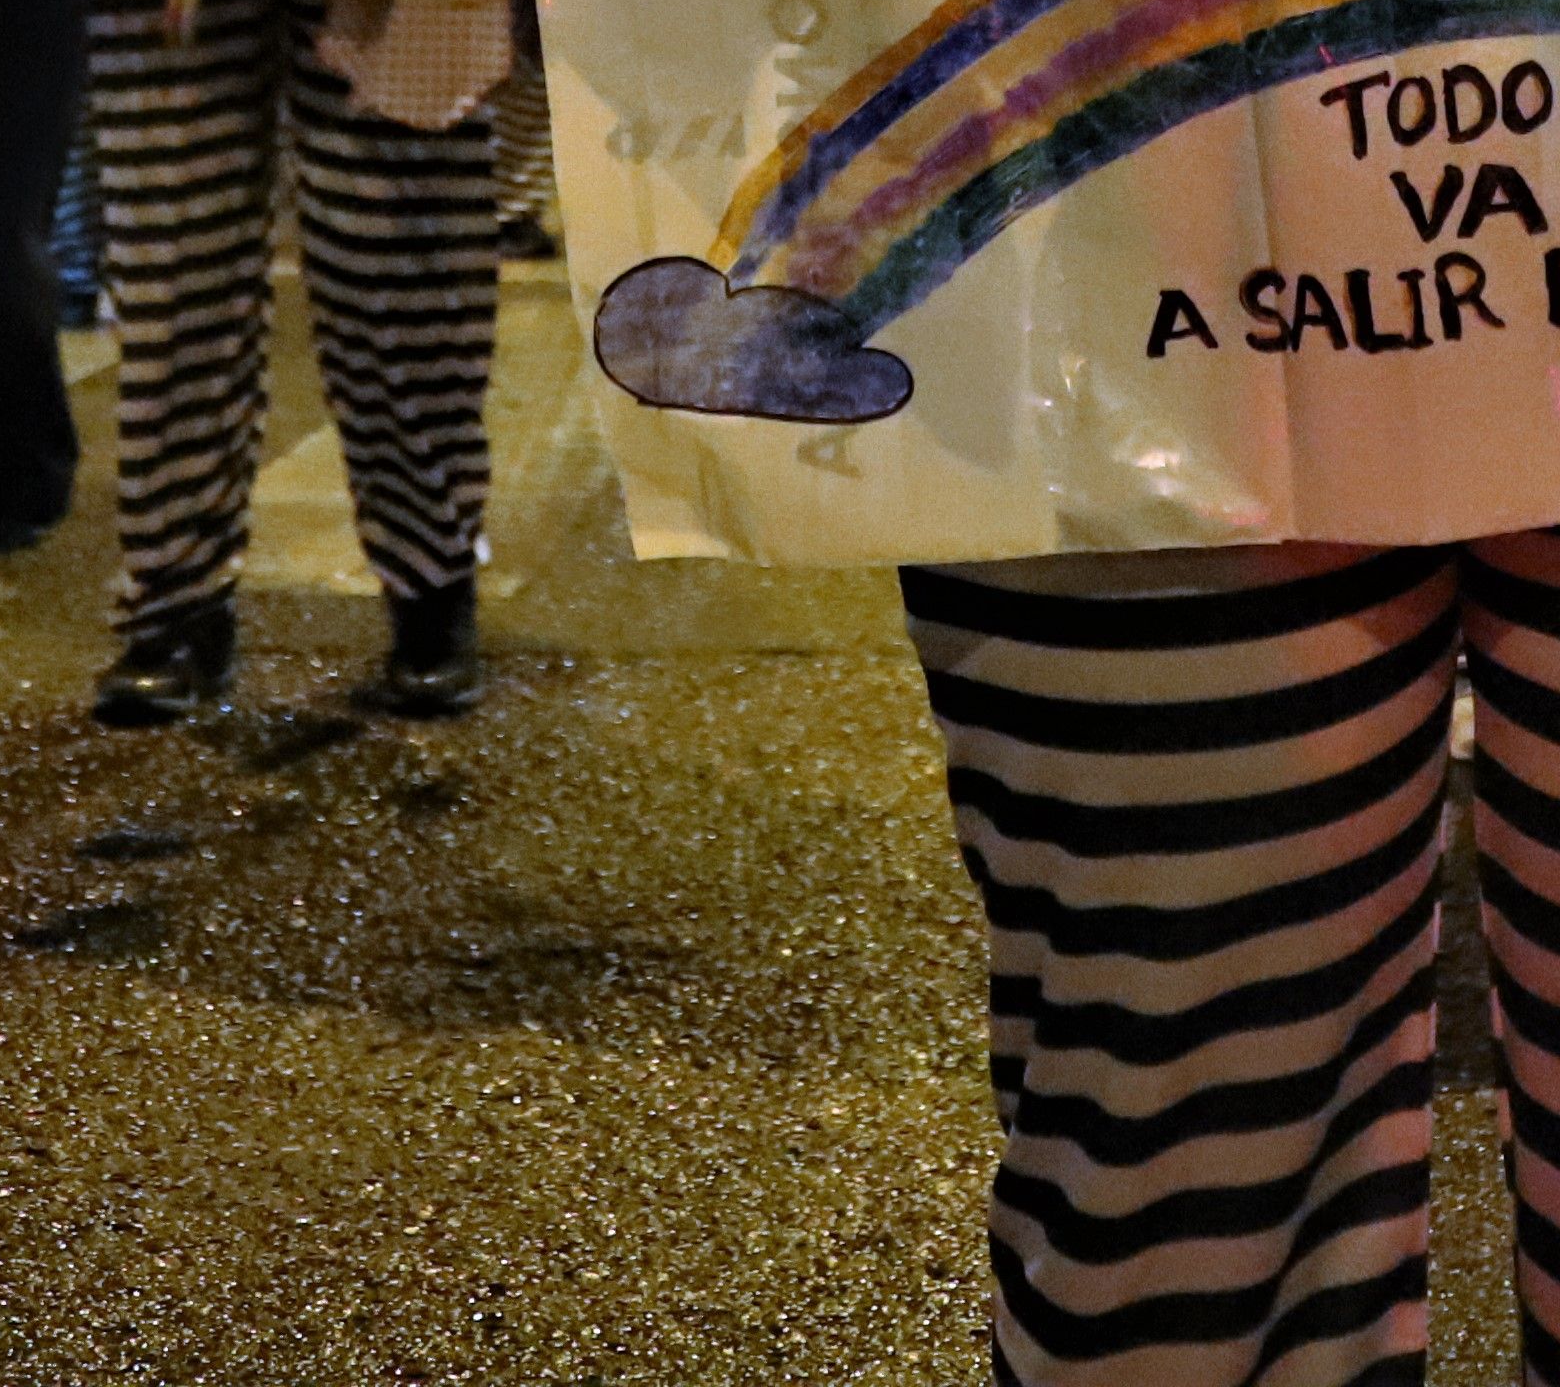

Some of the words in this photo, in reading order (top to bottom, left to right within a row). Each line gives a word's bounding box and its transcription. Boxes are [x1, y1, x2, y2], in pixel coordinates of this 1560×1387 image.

[1320, 59, 1554, 160] TODO
[1390, 163, 1549, 243] VA
[1146, 289, 1219, 358] A
[1239, 250, 1507, 354] SALIR
